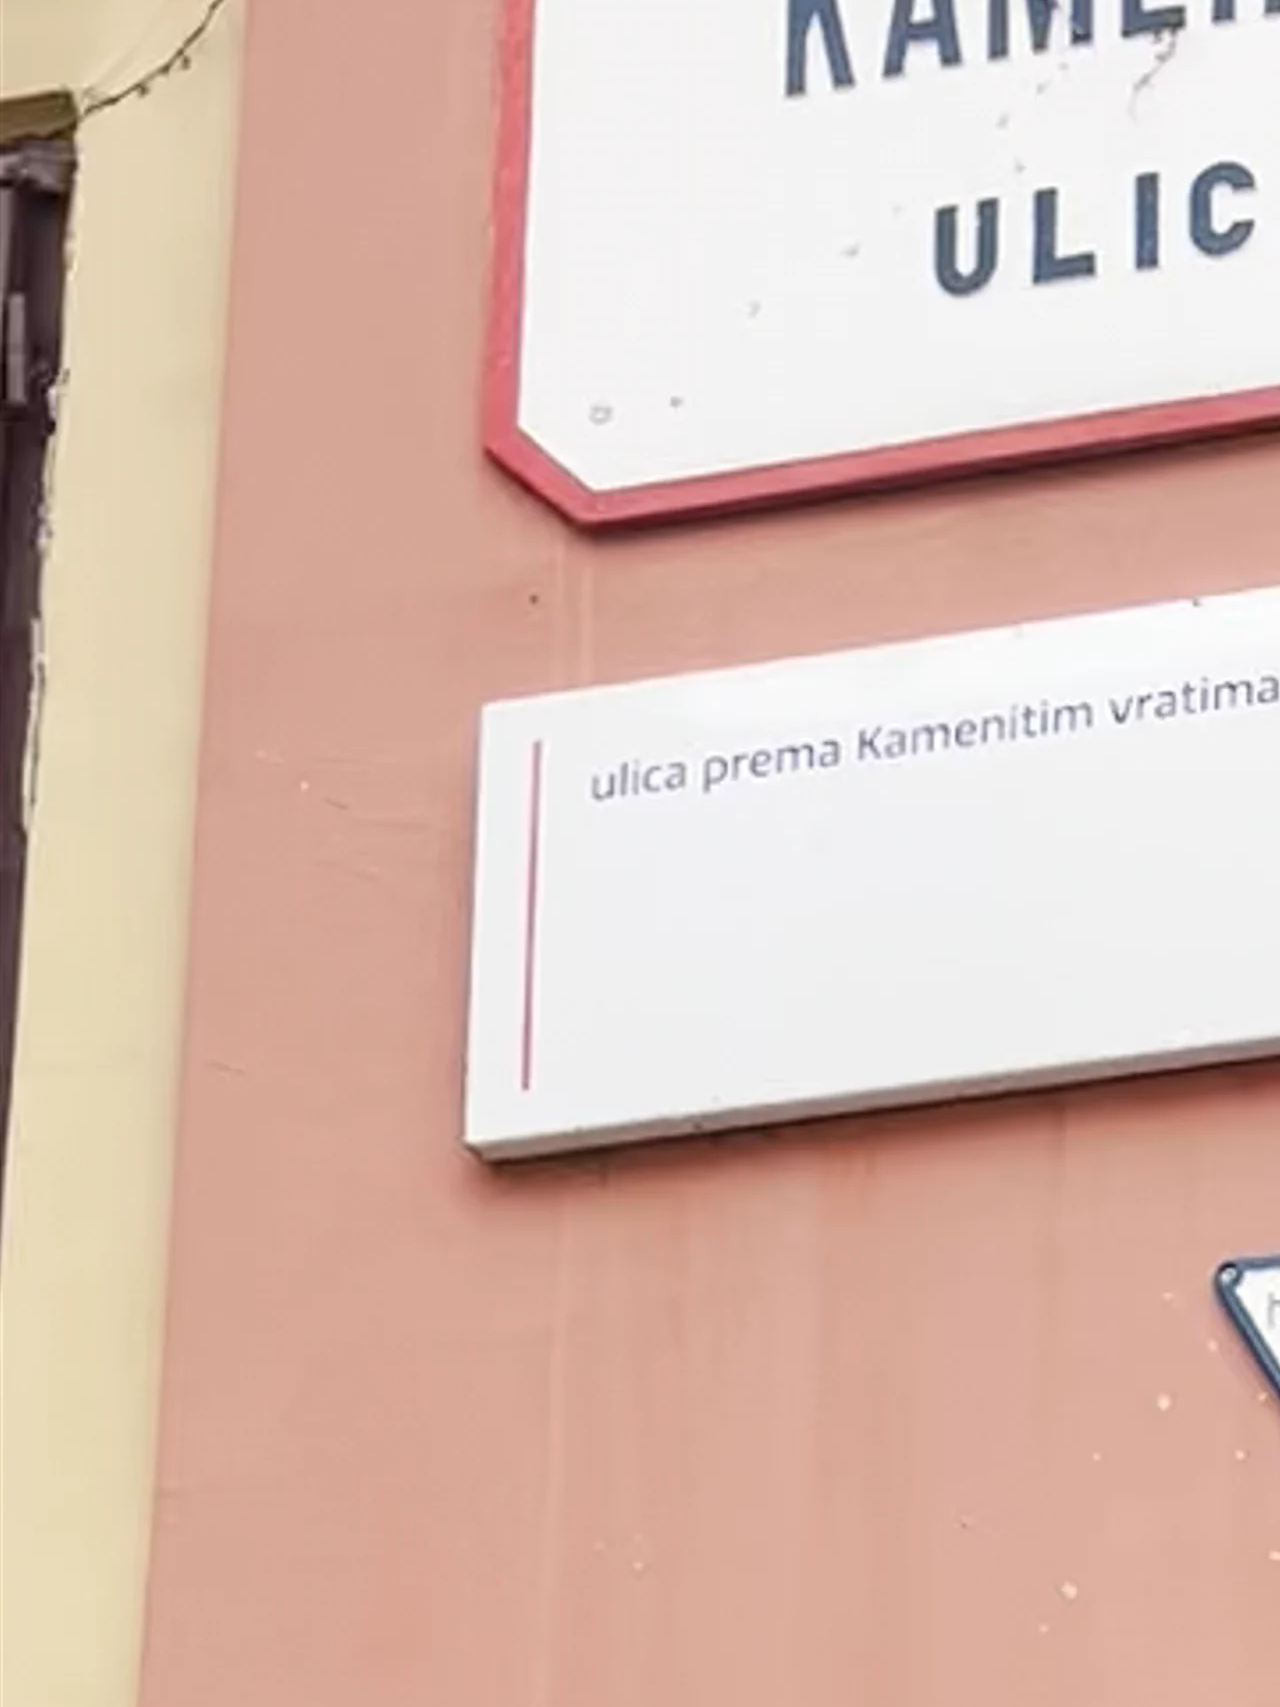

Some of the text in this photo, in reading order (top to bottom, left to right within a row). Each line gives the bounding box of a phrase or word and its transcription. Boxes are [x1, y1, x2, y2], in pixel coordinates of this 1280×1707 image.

[590, 759, 688, 802] ulica
[702, 736, 841, 792] prema
[856, 697, 1096, 761] Kamenitim
[1109, 675, 1280, 725] vratima
